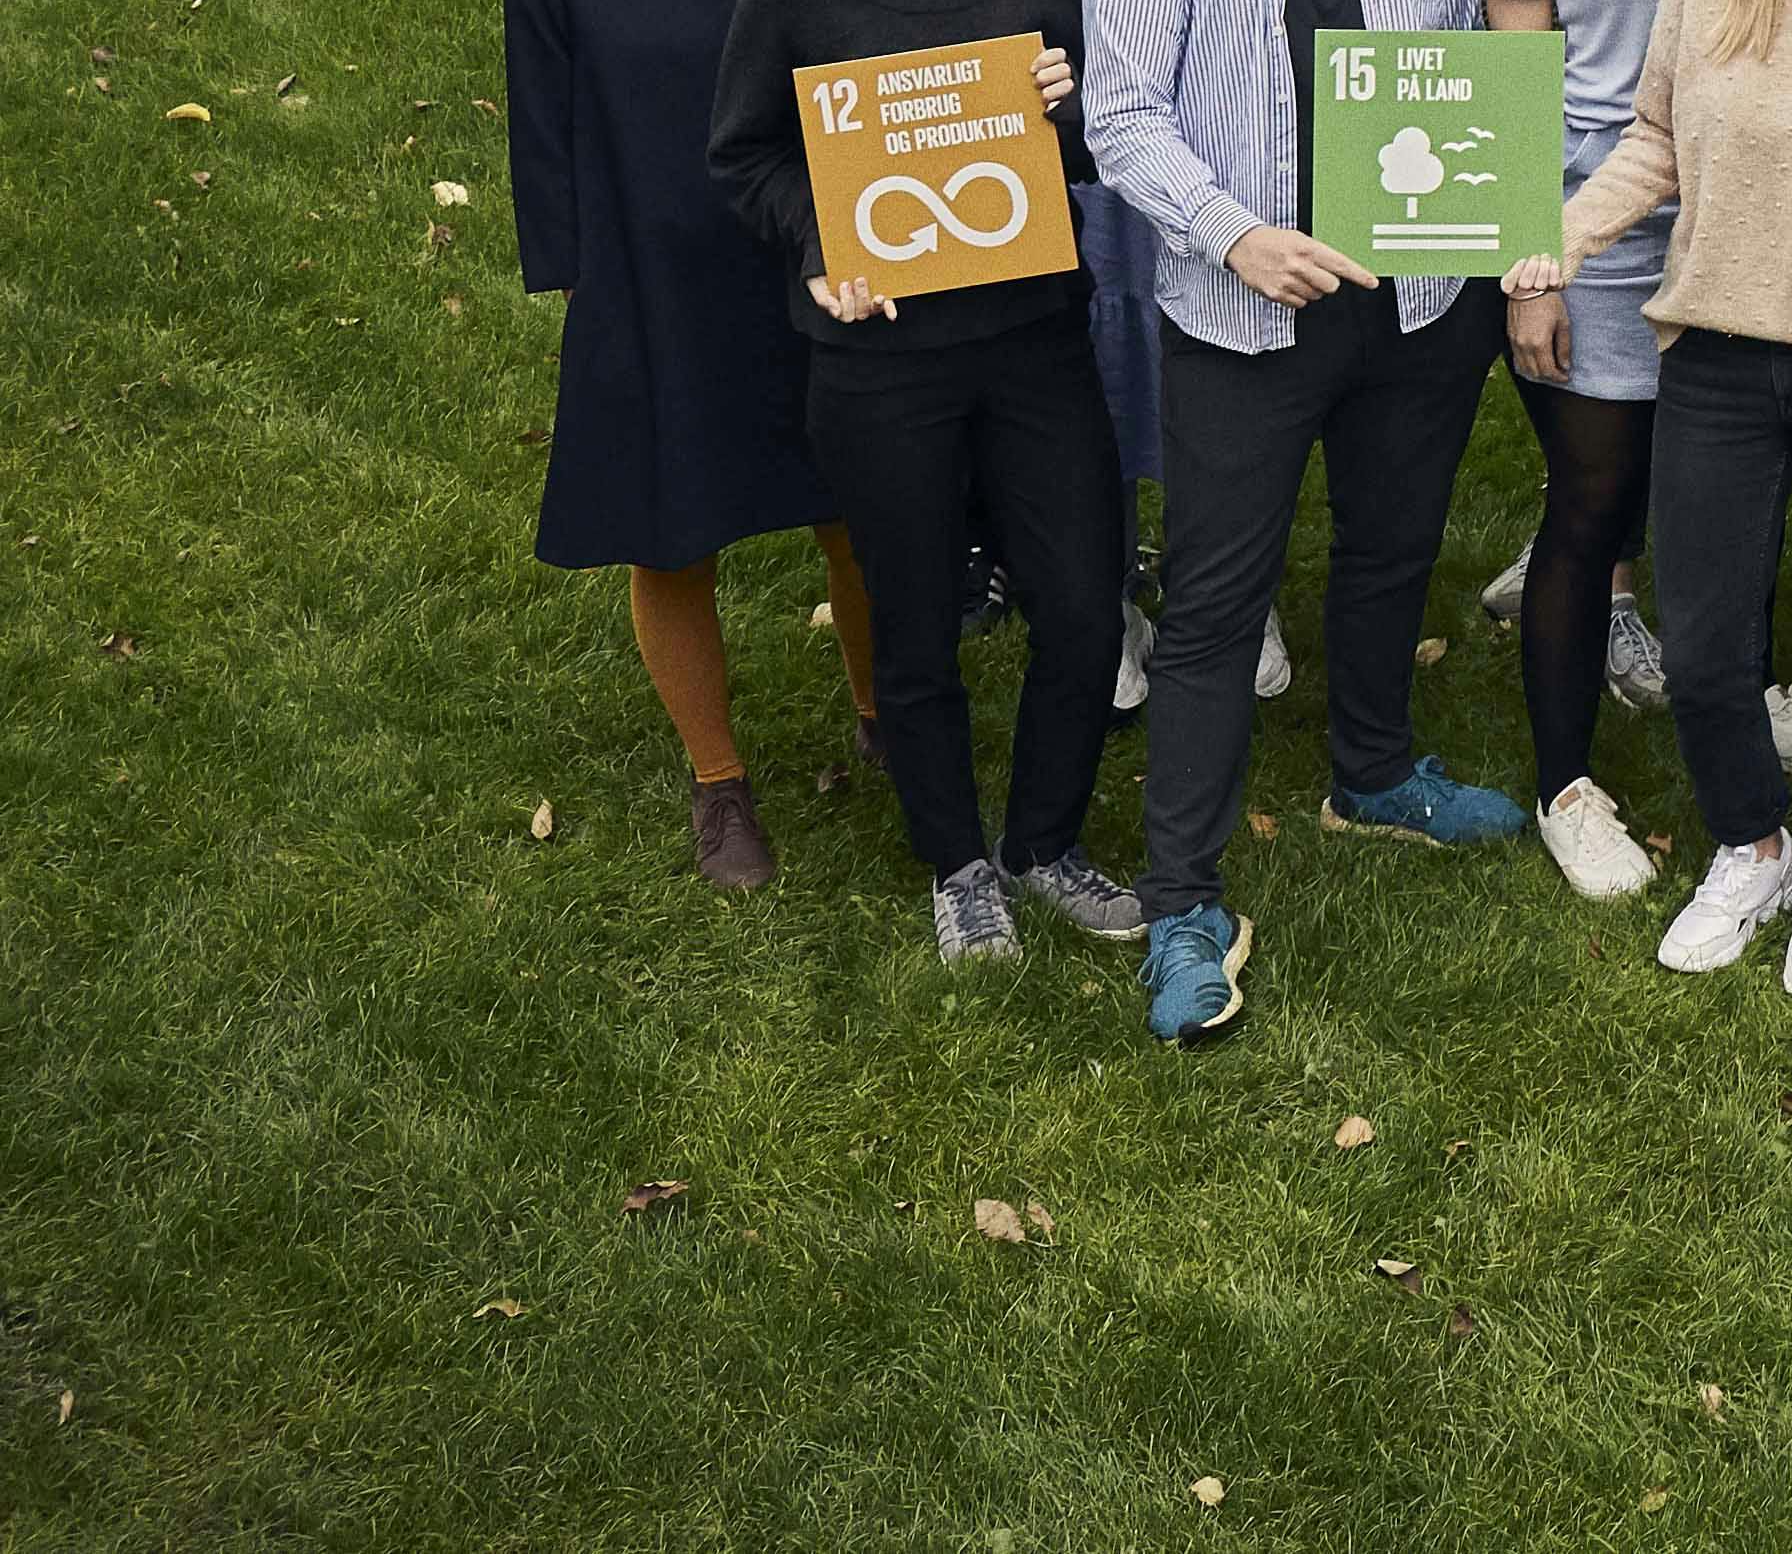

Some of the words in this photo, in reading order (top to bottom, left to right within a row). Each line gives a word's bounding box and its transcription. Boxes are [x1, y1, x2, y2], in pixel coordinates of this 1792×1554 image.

[877, 59, 982, 96] ANSVARLIGT
[1329, 47, 1377, 101] 15
[1396, 48, 1446, 71] LIVET
[813, 78, 863, 134] 12
[1396, 73, 1421, 102] PÅ
[1425, 79, 1473, 102] LAND
[880, 93, 962, 126] FORBRUG
[885, 130, 912, 155] OG
[914, 112, 1026, 150] PRODUKTION
